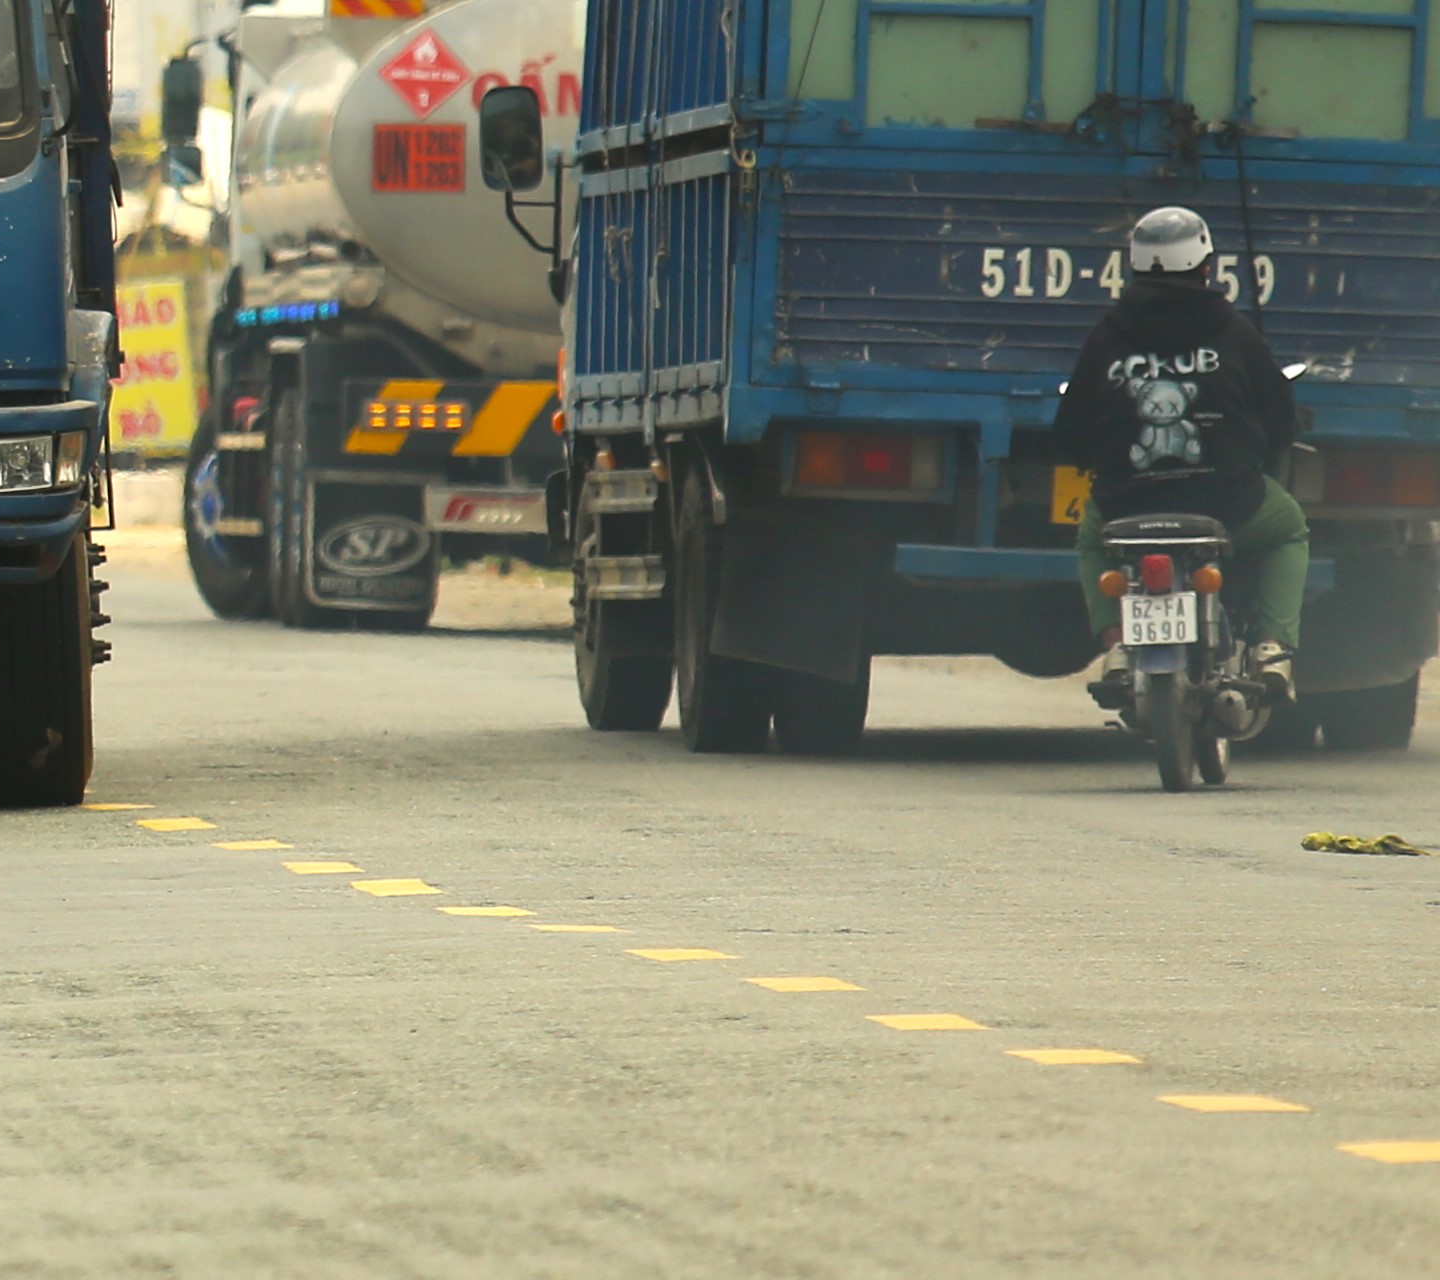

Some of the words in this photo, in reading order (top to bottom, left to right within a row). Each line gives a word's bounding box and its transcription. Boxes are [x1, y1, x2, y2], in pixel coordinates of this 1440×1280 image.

[981, 247, 1276, 306] 51D-459
[1132, 597, 1185, 620] 62-FA
[1132, 621, 1186, 643] 9690
